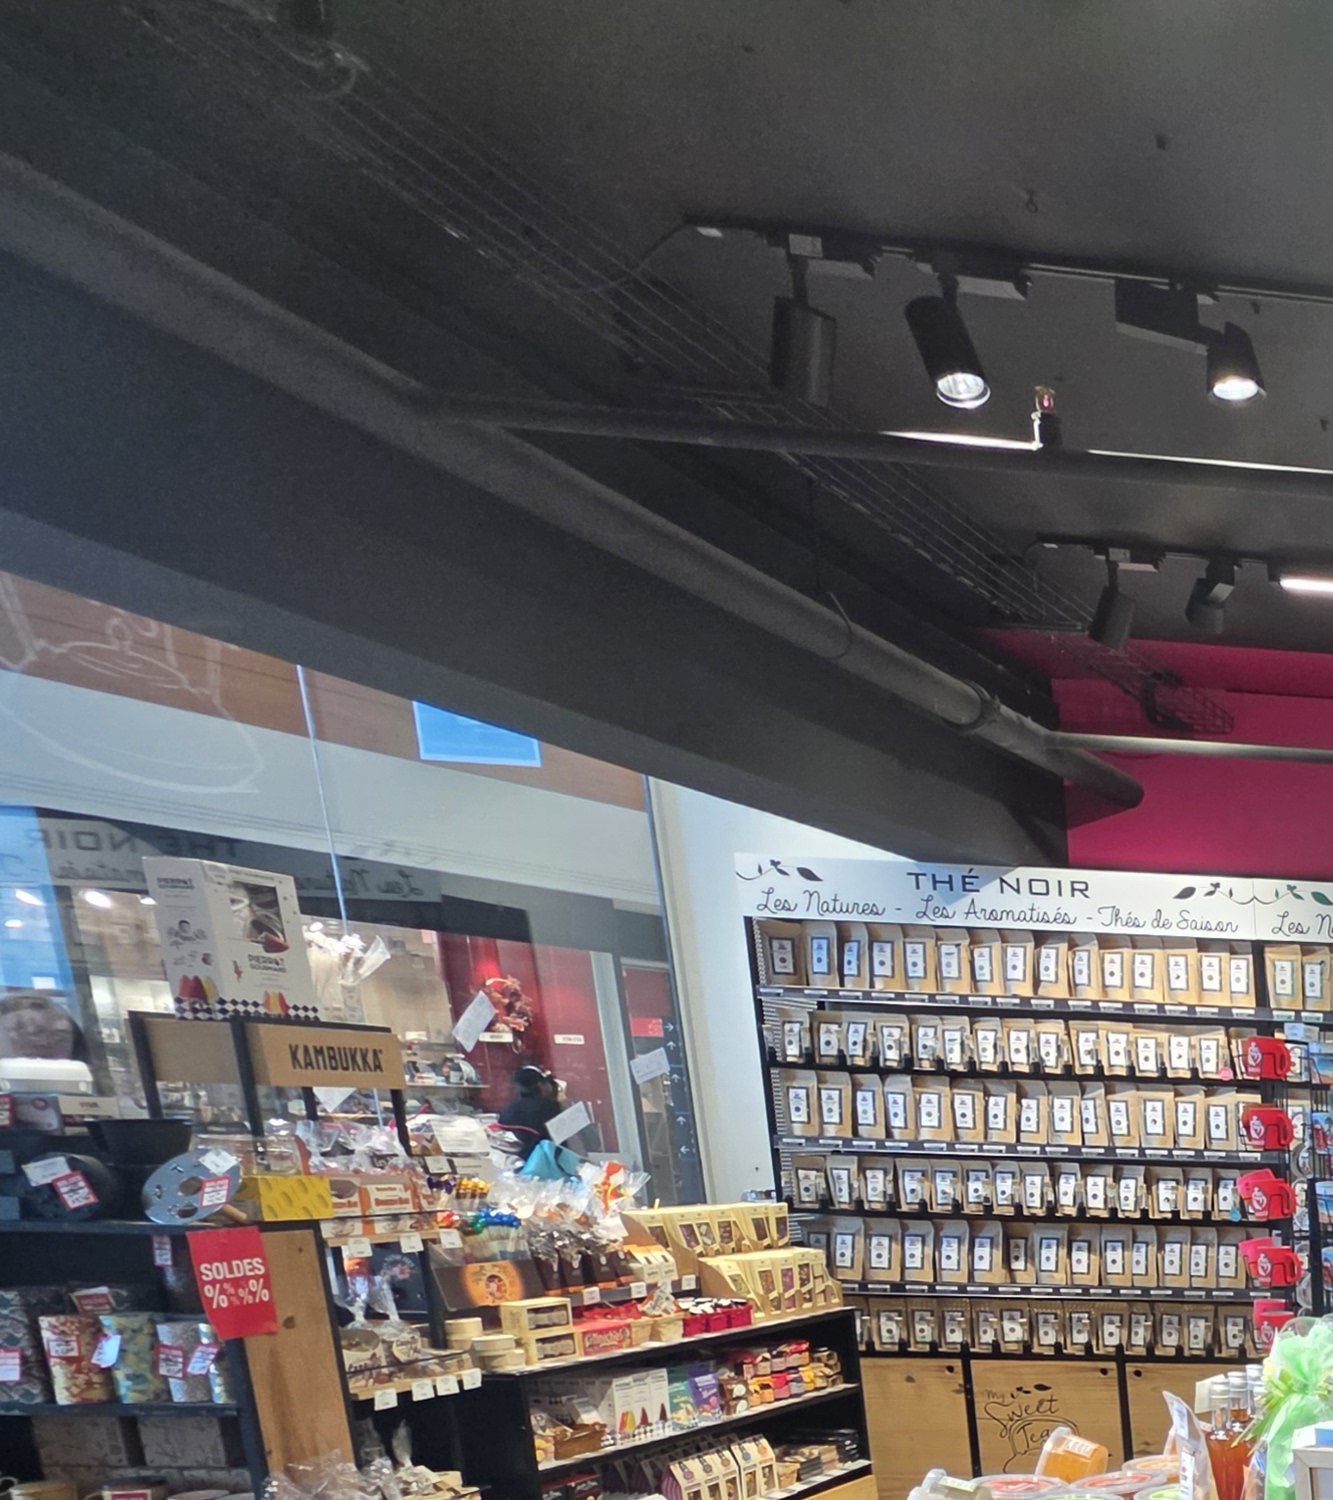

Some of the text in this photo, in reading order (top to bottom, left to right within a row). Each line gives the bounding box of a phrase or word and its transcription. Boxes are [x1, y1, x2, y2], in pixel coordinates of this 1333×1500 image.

[906, 868, 1090, 898] THÉ NOIR
[756, 887, 1238, 933] Les Natures Les Aromatisés Thés de Saison
[1271, 911, 1310, 937] Les
[200, 1257, 265, 1281] SOLDES
[983, 1393, 1059, 1438] Sweet
[1014, 1422, 1051, 1448] Tea
